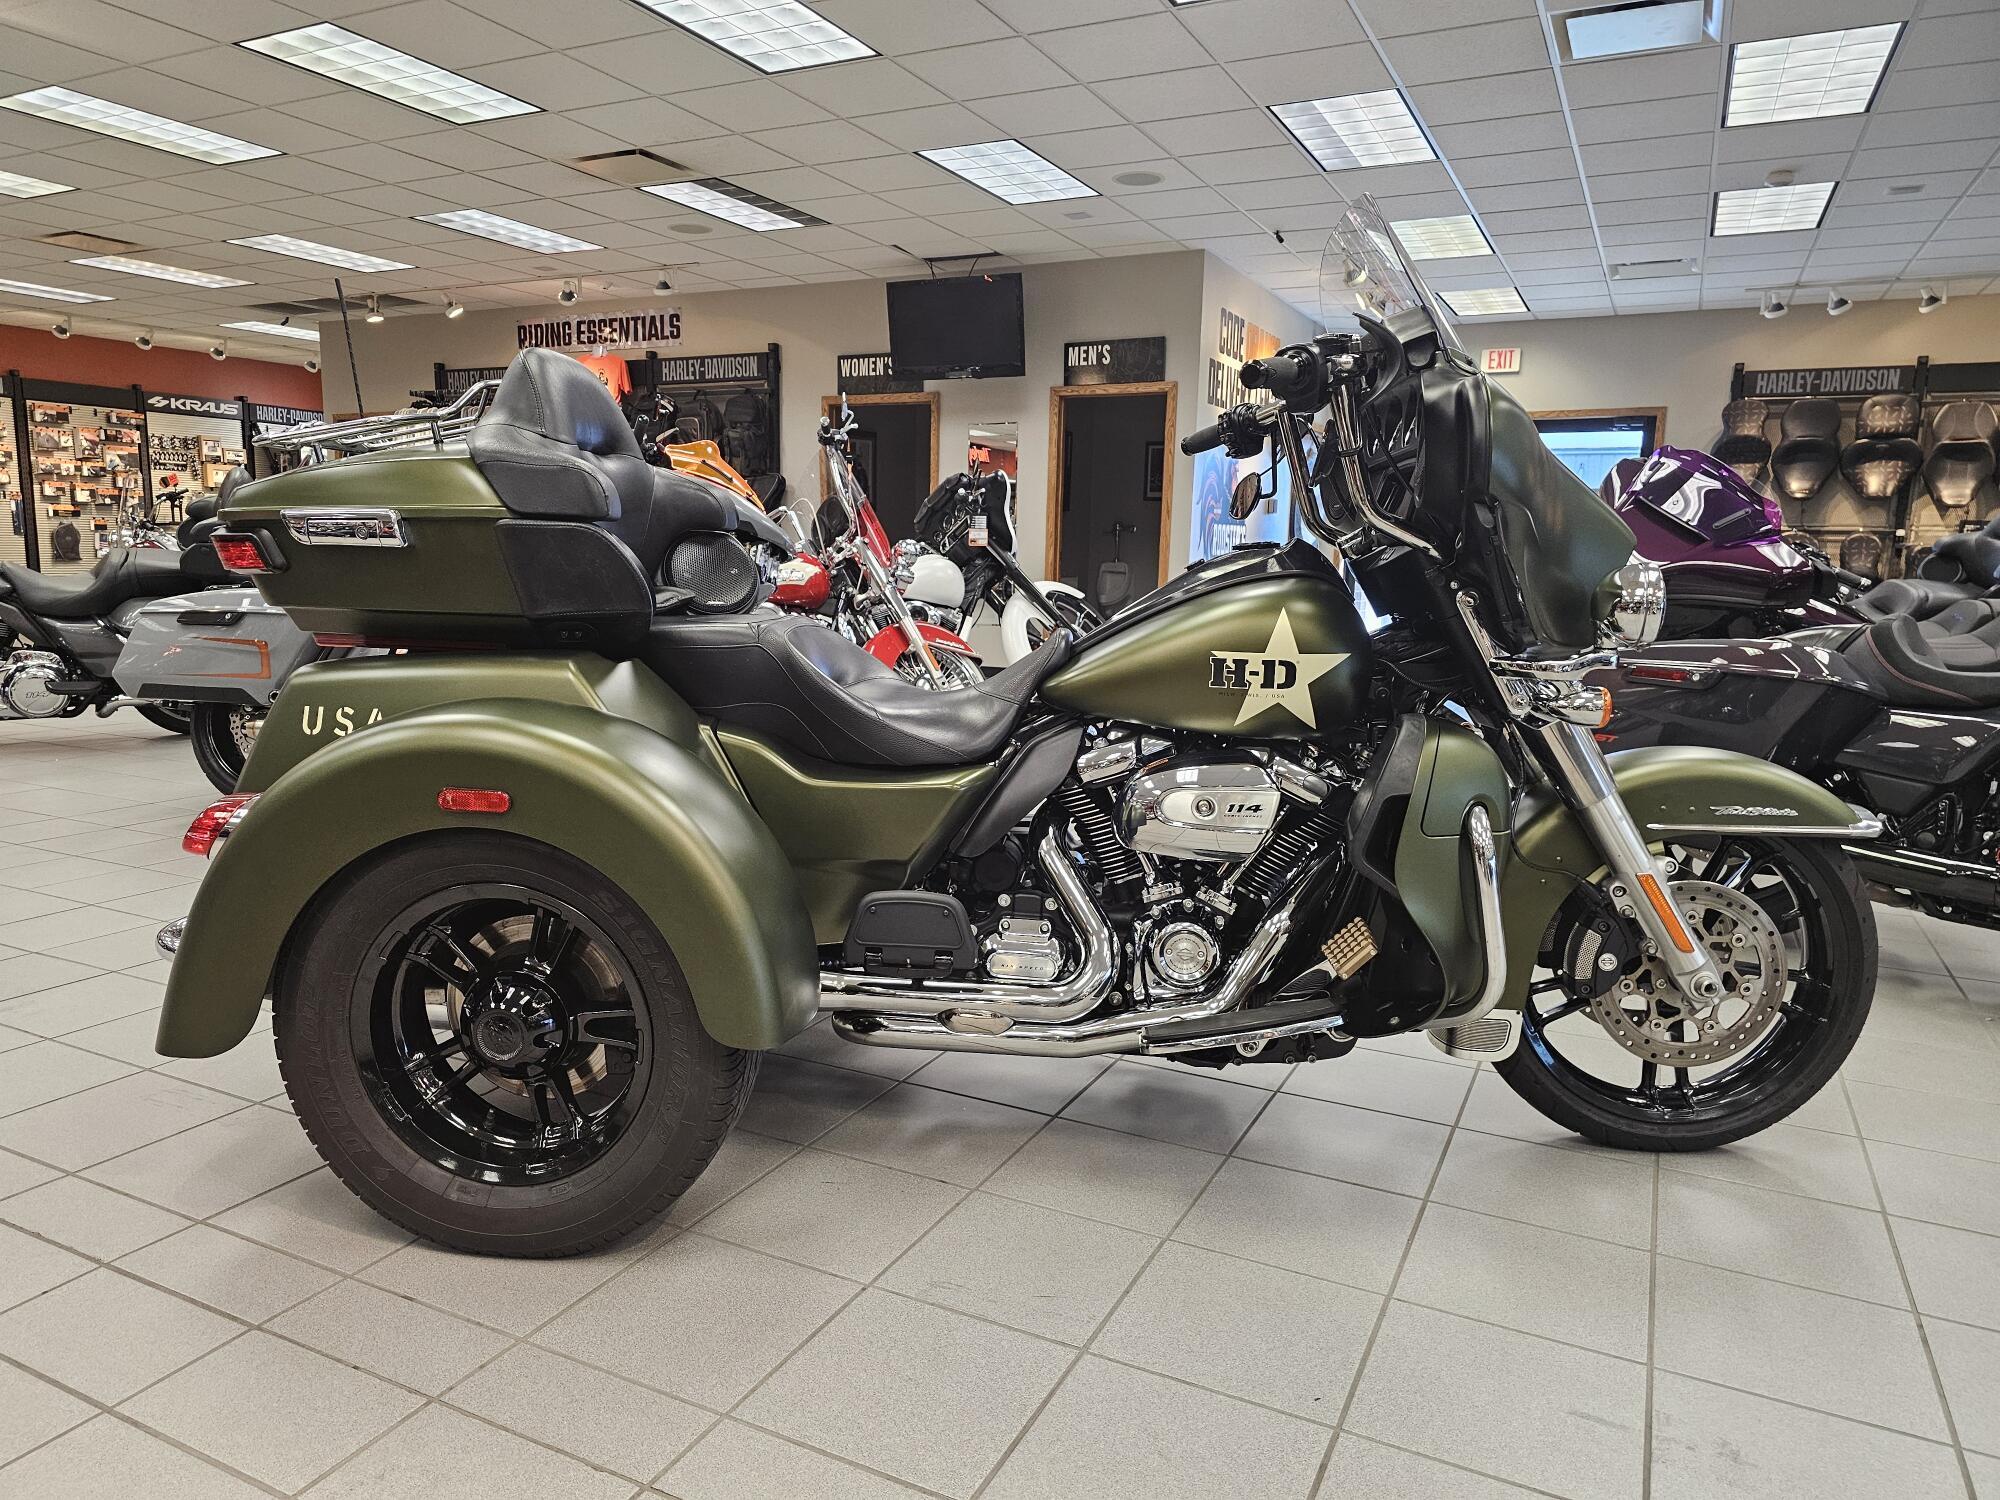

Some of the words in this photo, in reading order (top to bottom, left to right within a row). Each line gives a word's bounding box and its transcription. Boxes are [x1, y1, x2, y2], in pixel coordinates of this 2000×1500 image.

[517, 320, 572, 350] RIDING
[576, 313, 681, 345] ESSENTIALS
[1219, 307, 1245, 363] CODE
[1068, 344, 1111, 367] MEN'S
[1488, 350, 1515, 369] EXIT
[662, 356, 759, 382] HARLEY-DAVIDSON
[1755, 368, 1901, 394] HARLEY-DAVIDSON
[170, 397, 239, 416] KRAUS
[1208, 656, 1297, 690] H-D
[1226, 804, 1264, 813] 114
